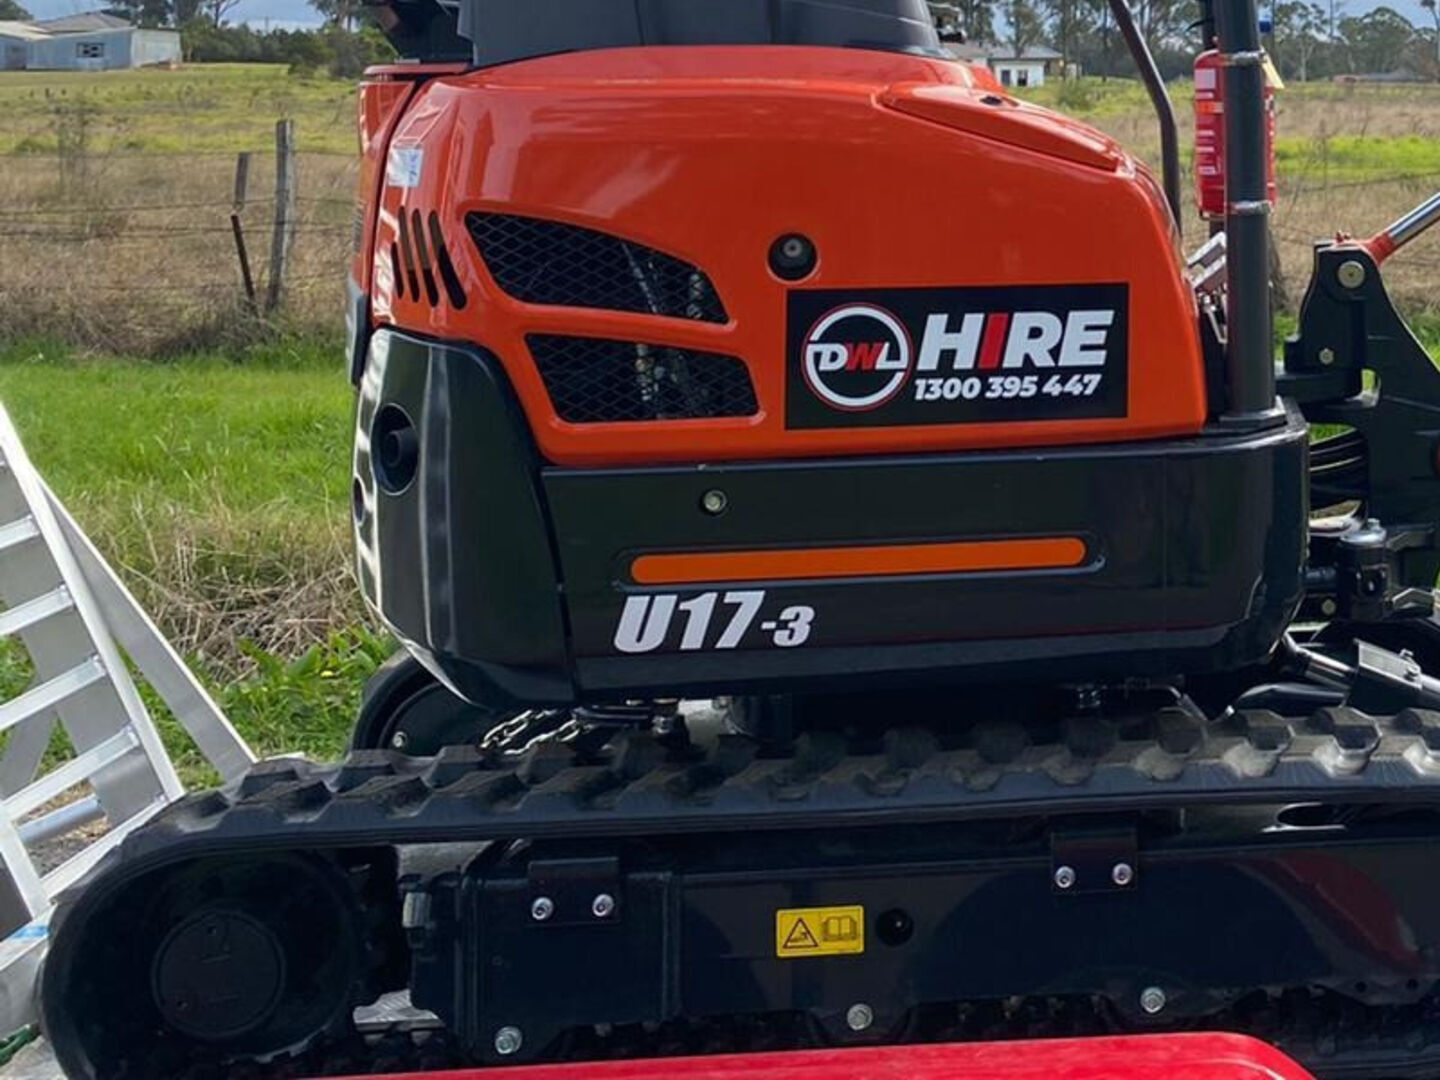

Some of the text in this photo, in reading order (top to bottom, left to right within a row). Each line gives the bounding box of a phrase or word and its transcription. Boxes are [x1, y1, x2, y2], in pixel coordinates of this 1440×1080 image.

[809, 309, 1115, 372] DWL HIRE
[915, 374, 1101, 400] 1300 395 447
[613, 590, 816, 653] U17-3
